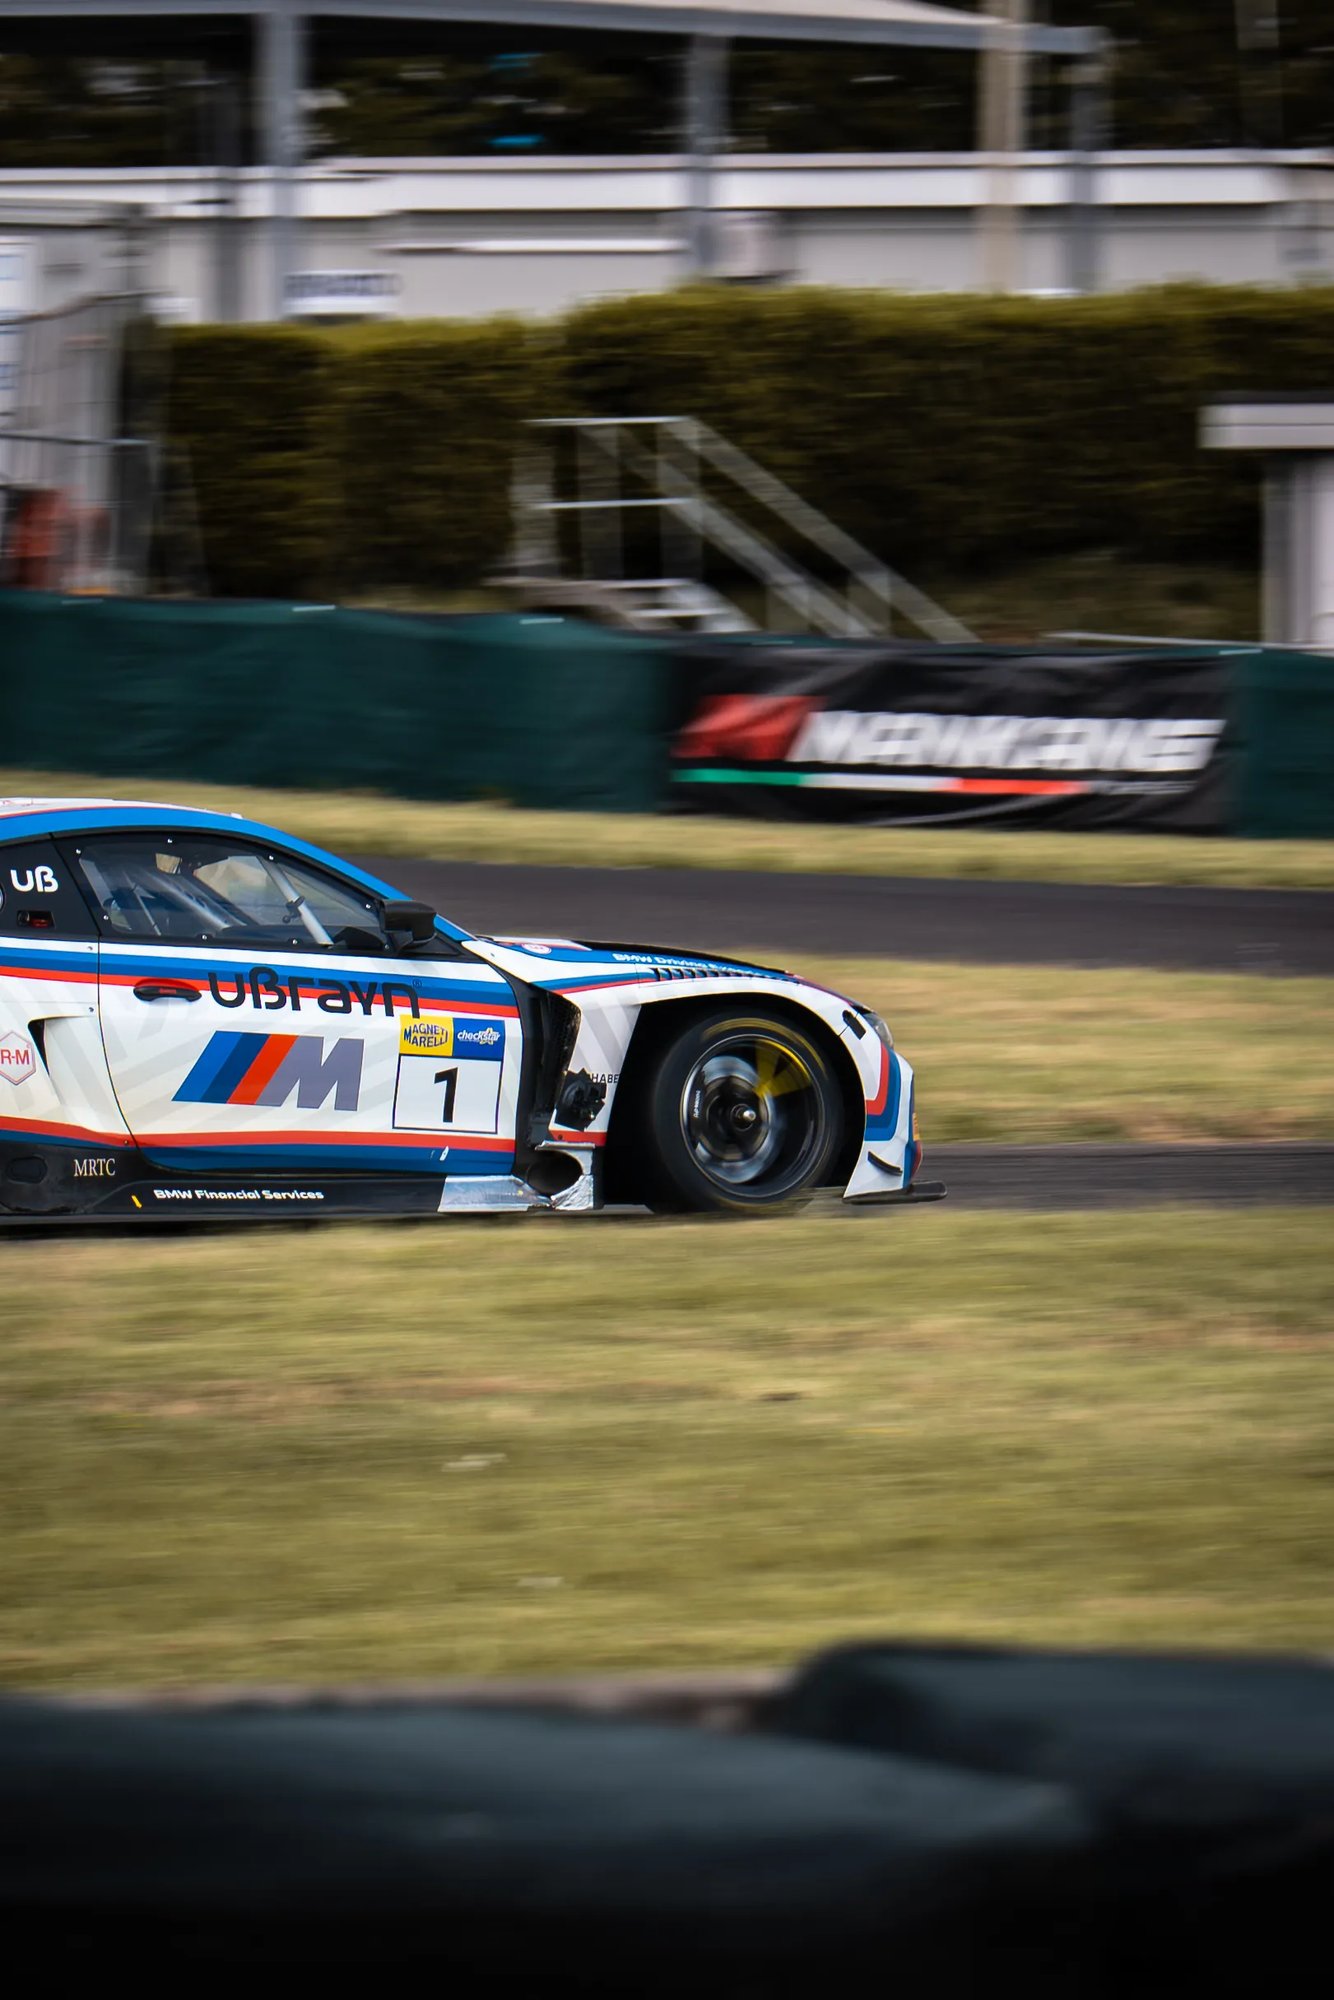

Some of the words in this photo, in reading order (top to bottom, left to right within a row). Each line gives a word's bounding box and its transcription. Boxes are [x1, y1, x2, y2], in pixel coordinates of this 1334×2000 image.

[404, 1023, 448, 1040] MAGNETI
[404, 1029, 448, 1047] MARELLI
[0, 1049, 29, 1065] R-M
[434, 1067, 458, 1123] 1
[74, 1158, 115, 1177] MRTC
[153, 1189, 192, 1200] BMW
[195, 1189, 260, 1200] Financial
[261, 1190, 324, 1200] Services
